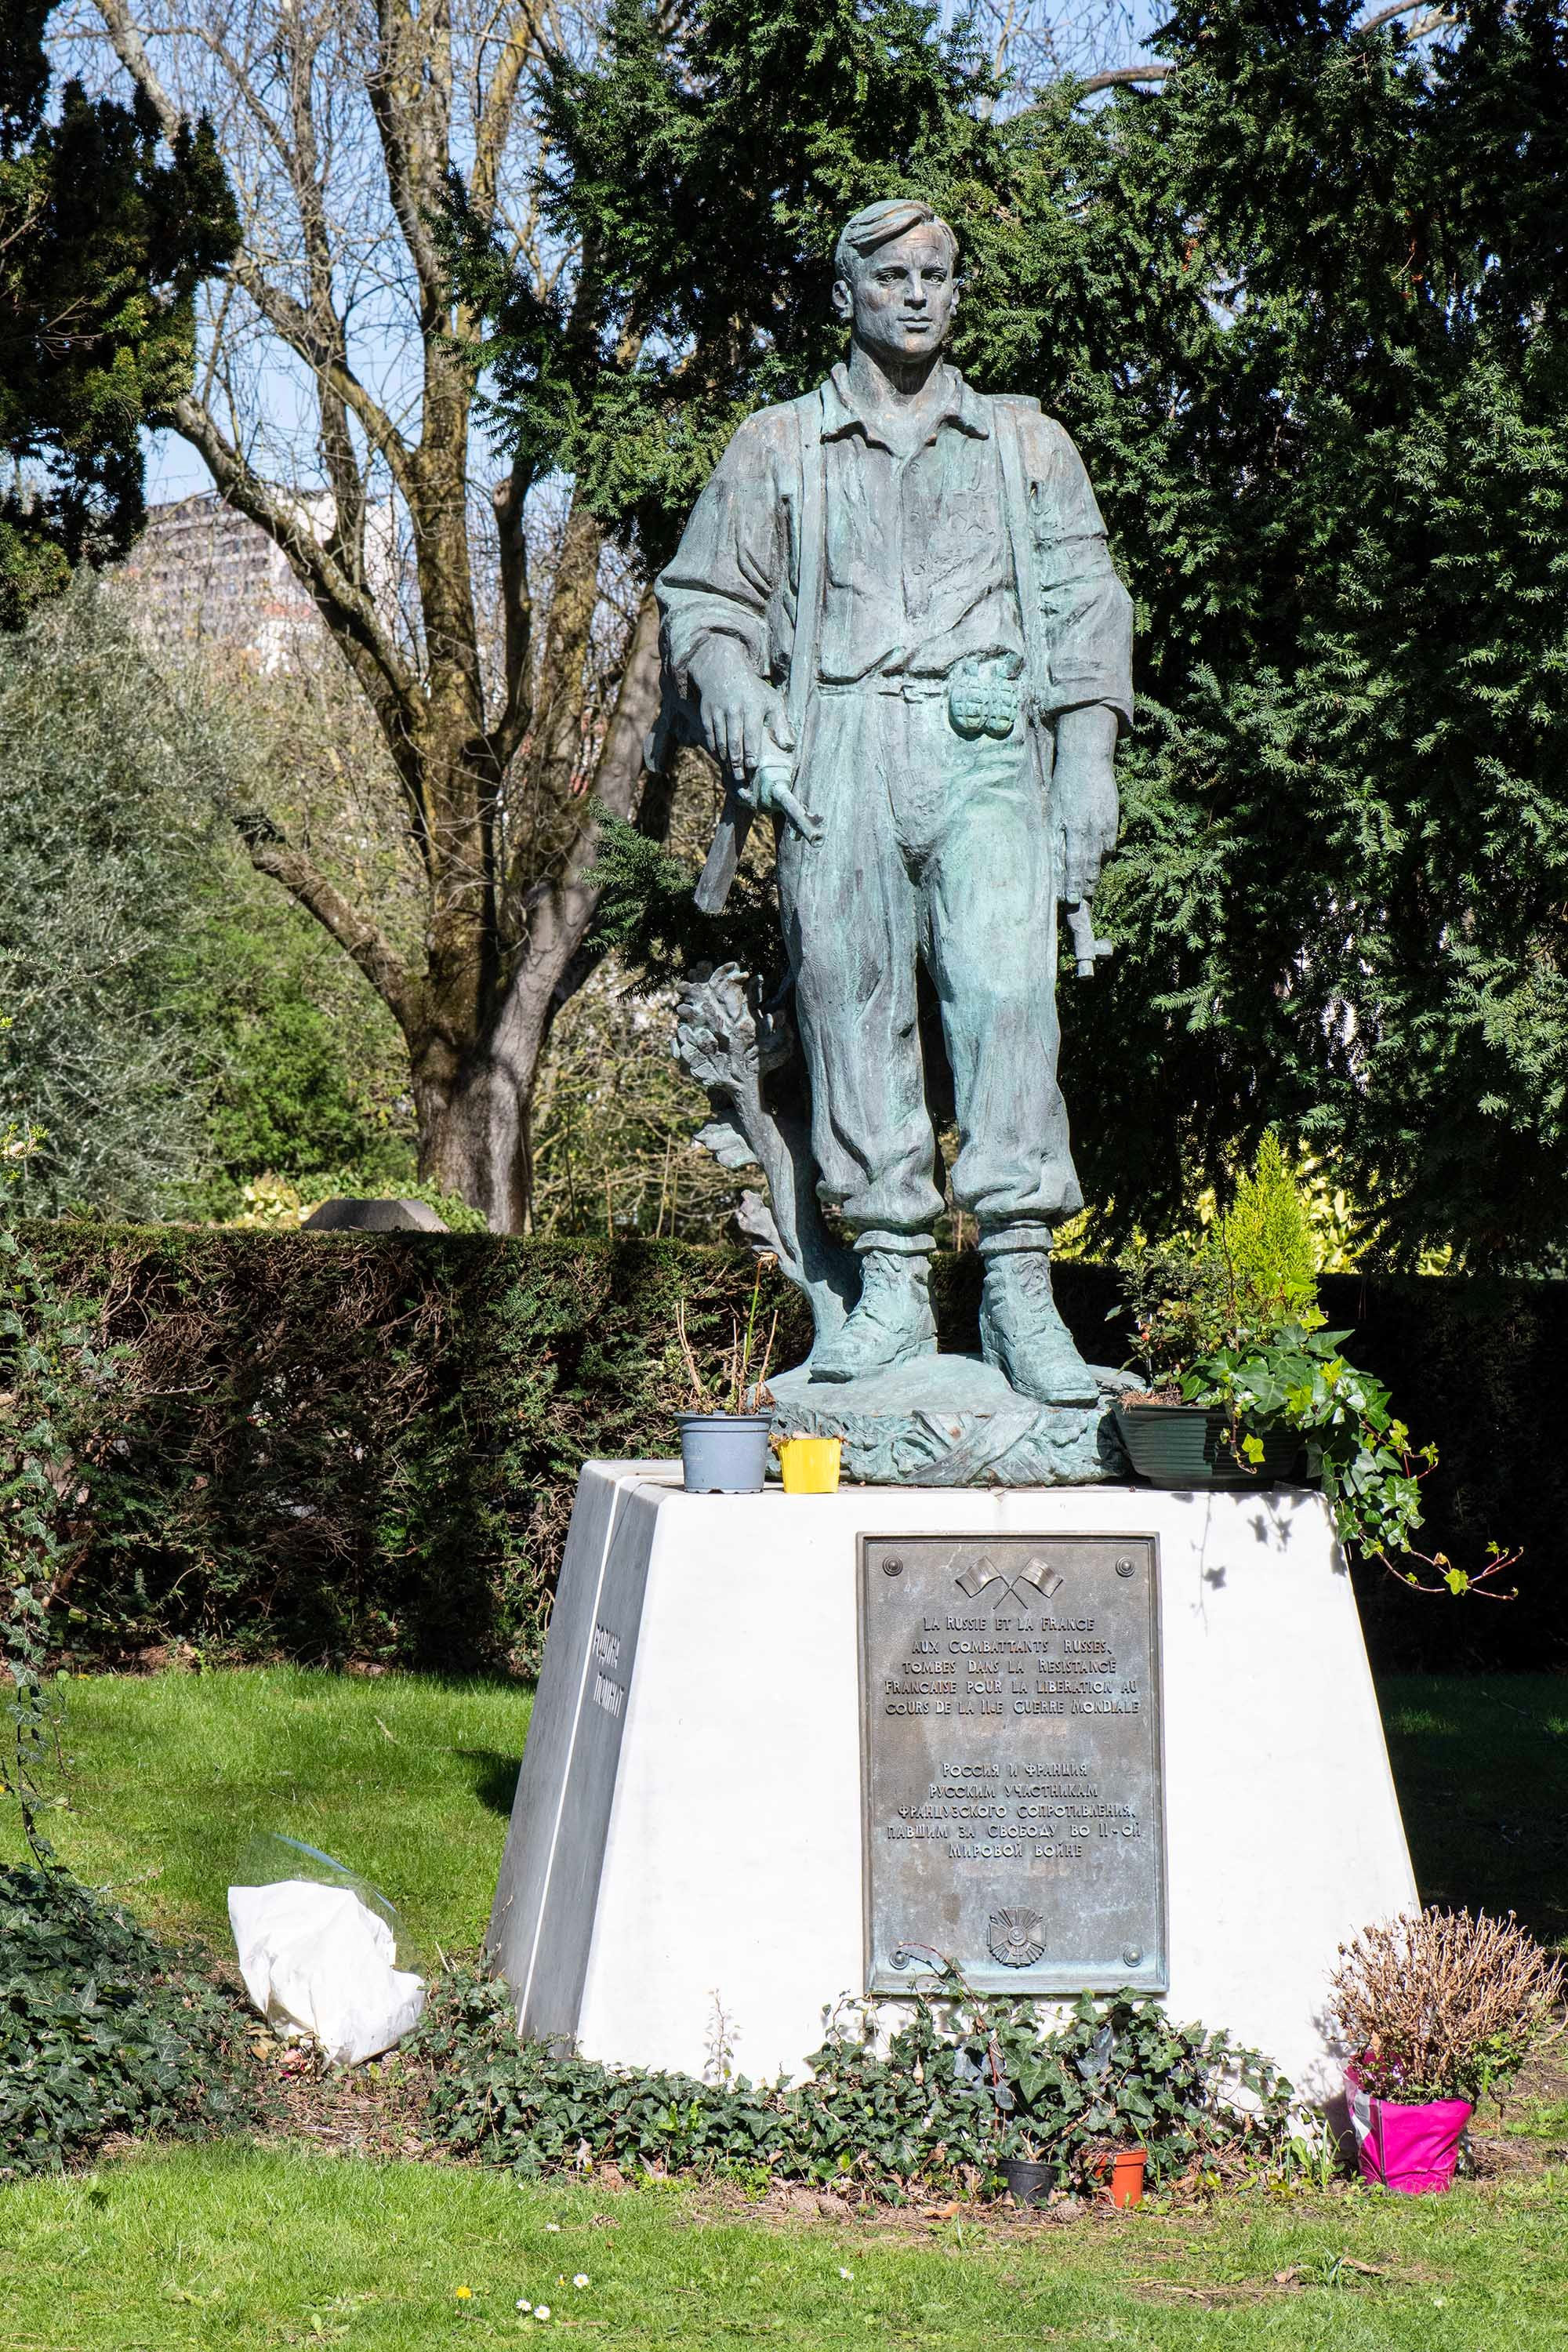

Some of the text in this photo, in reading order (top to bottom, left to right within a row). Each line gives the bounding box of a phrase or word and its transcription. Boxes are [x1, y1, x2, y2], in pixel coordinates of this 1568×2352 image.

[924, 1616, 1094, 1631] LA RUSSIE ET LA FRANCE
[912, 1640, 939, 1653] AUX
[949, 1639, 1048, 1653] COMBATTANTS
[902, 1659, 1116, 1674] TOMBES DANS LA RESISTANCE
[884, 1680, 1137, 1694] FRANCAISE POUR LA LIBERATION AU
[886, 1700, 929, 1715] COURS
[935, 1700, 951, 1715] DE
[958, 1701, 974, 1715] LA
[1014, 1700, 1064, 1715] GUERRE
[1071, 1699, 1139, 1715] MONDIALE
[942, 1762, 1088, 1777] РОССИЯ И ФРАНЦИЯ
[929, 1783, 1098, 1798] РУССКИМ УЧАСТНИКАМ
[898, 1805, 1007, 1820] ФРАНЦУЗСКОГО
[887, 1824, 948, 1839] ПАВШИМ
[958, 1825, 975, 1838] ЗА
[988, 1824, 1058, 1838] СВОБОДУ
[1070, 1824, 1091, 1838] ВО
[949, 1842, 1083, 1858] МИРОВОЙ ВОЙНЕ
